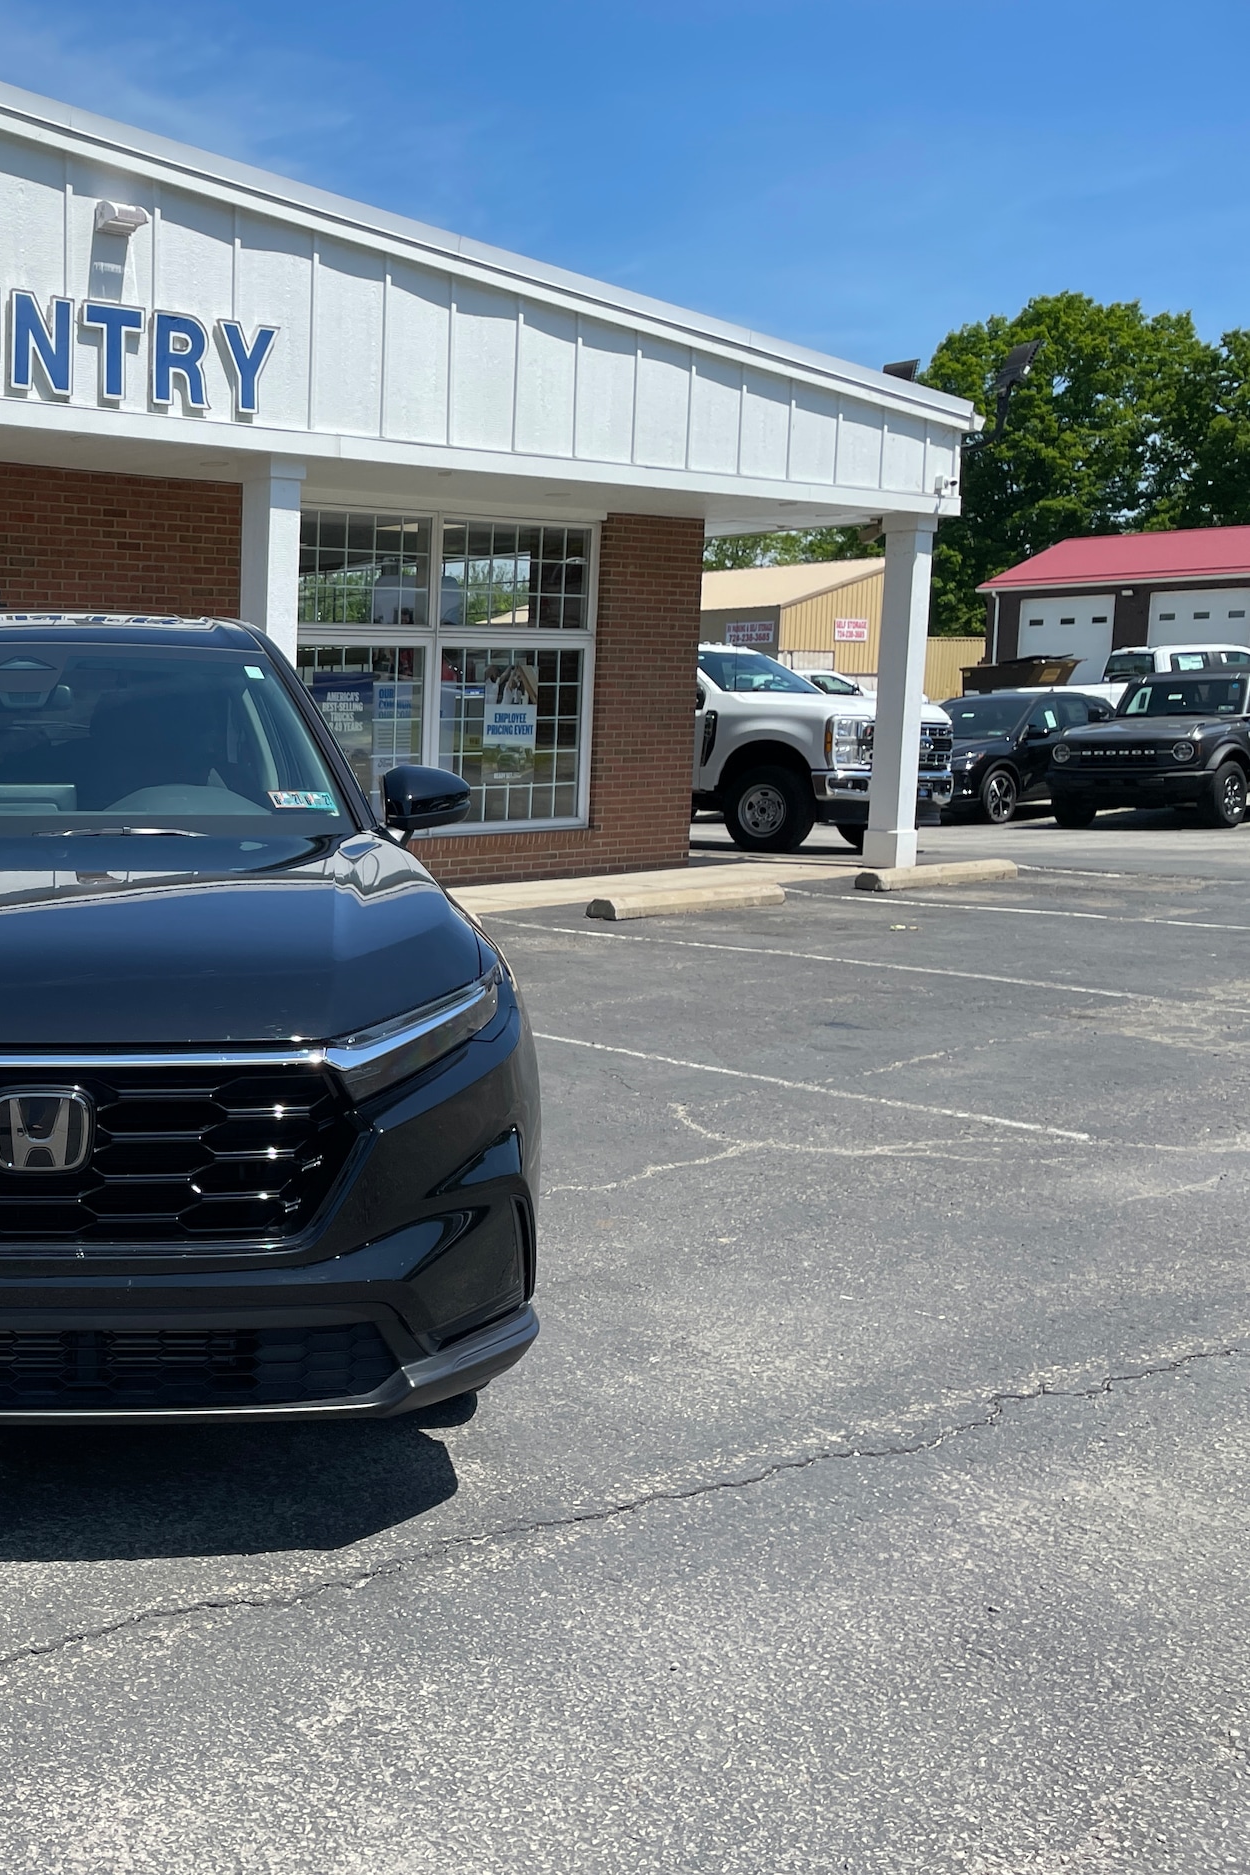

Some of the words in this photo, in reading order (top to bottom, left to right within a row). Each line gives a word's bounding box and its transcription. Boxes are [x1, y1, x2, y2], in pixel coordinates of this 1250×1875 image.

[326, 691, 360, 702] AMERICA'S
[322, 702, 364, 712] BEST-SELLING
[330, 712, 355, 722] TRUCKS
[494, 712, 527, 724] EMPLOYEE
[343, 721, 363, 732] YEARS
[486, 724, 513, 735] PRICING
[514, 724, 534, 735] EVENT
